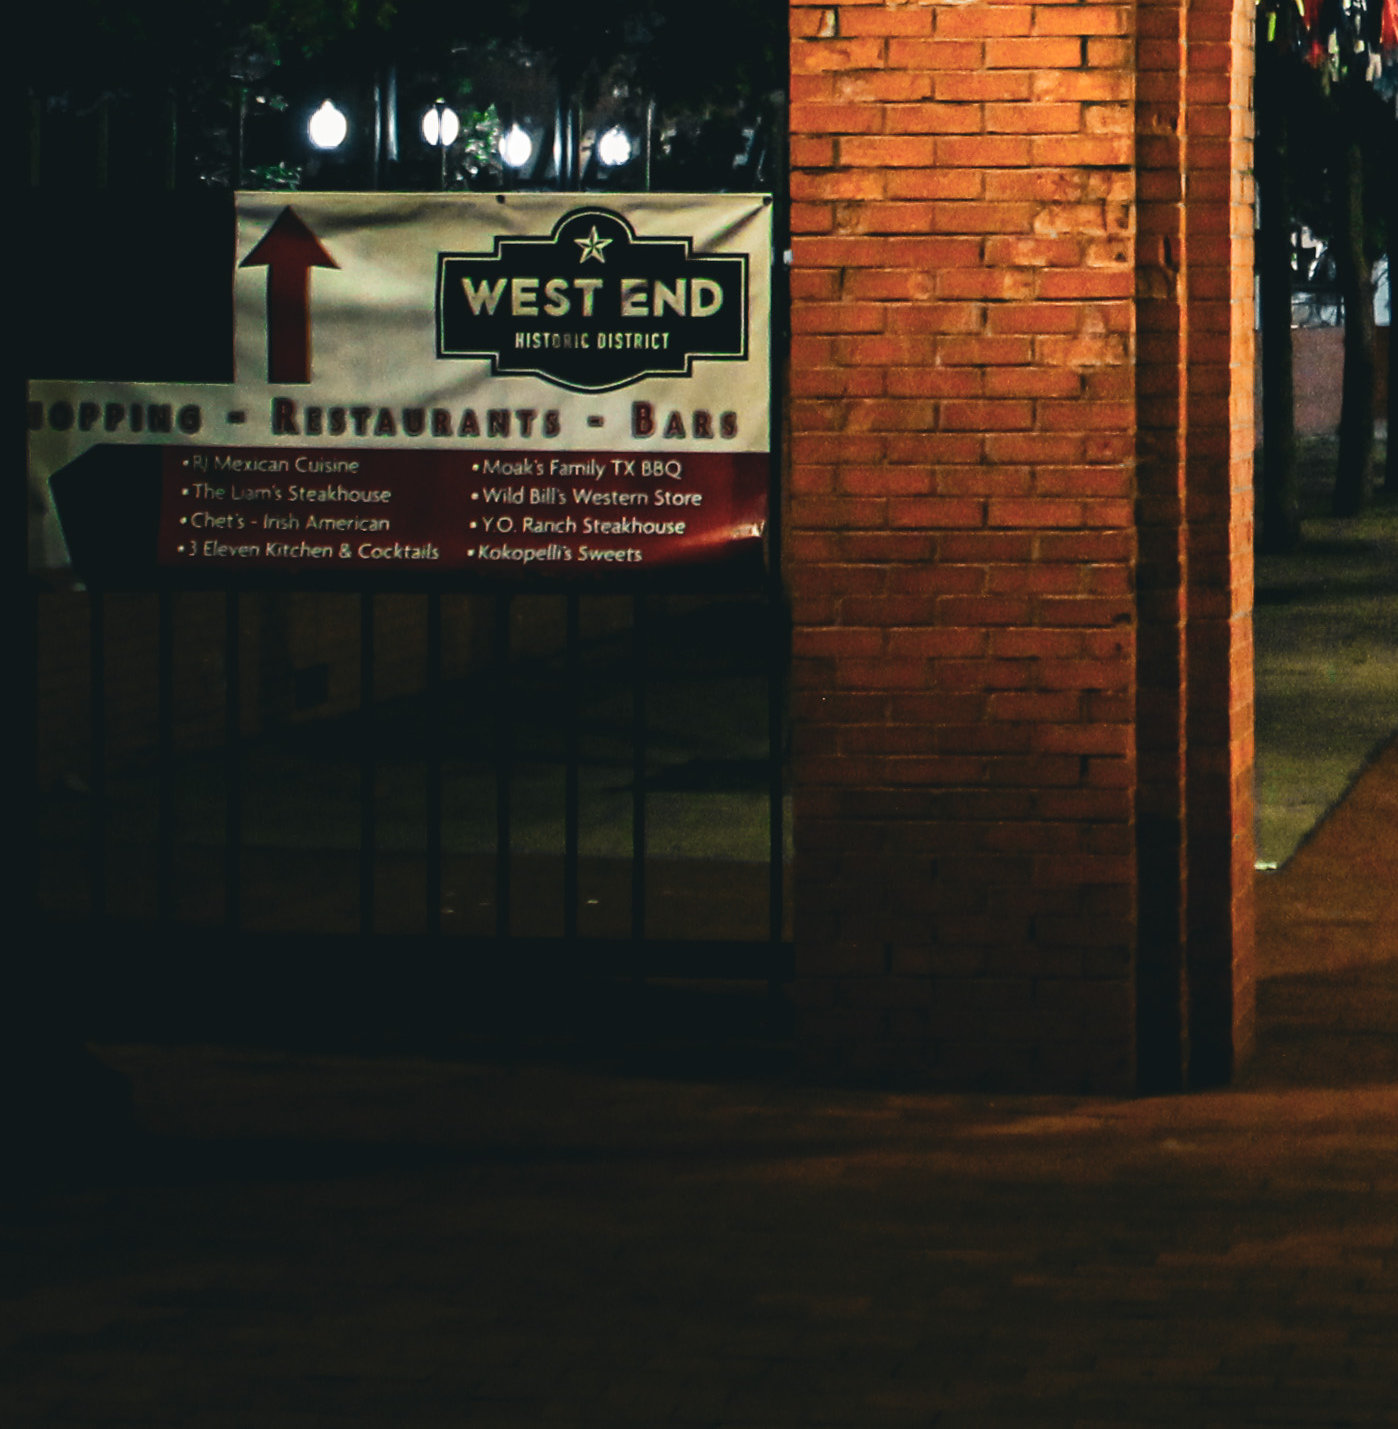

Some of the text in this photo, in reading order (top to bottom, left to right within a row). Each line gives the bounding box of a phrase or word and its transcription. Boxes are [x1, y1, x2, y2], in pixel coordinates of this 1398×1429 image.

[460, 276, 724, 317] WEST END
[514, 331, 670, 350] HISTORIC DISTRICT
[215, 455, 289, 473] Mexican
[295, 456, 360, 474] Cuisine
[483, 459, 682, 481] Moak's Family TX BBQ
[193, 483, 225, 500] The
[288, 484, 392, 503] Steakhouse
[483, 487, 702, 508] Wild Bill's Western Store
[190, 511, 246, 529] Chet's
[263, 513, 299, 530] Irish
[305, 514, 390, 532] American
[523, 517, 577, 535] Ranch
[582, 517, 686, 535] Steakhouse
[188, 540, 439, 561] 3 Eleven Kitchen & Cocktails
[478, 544, 643, 564] Kokopelli's Sweets
